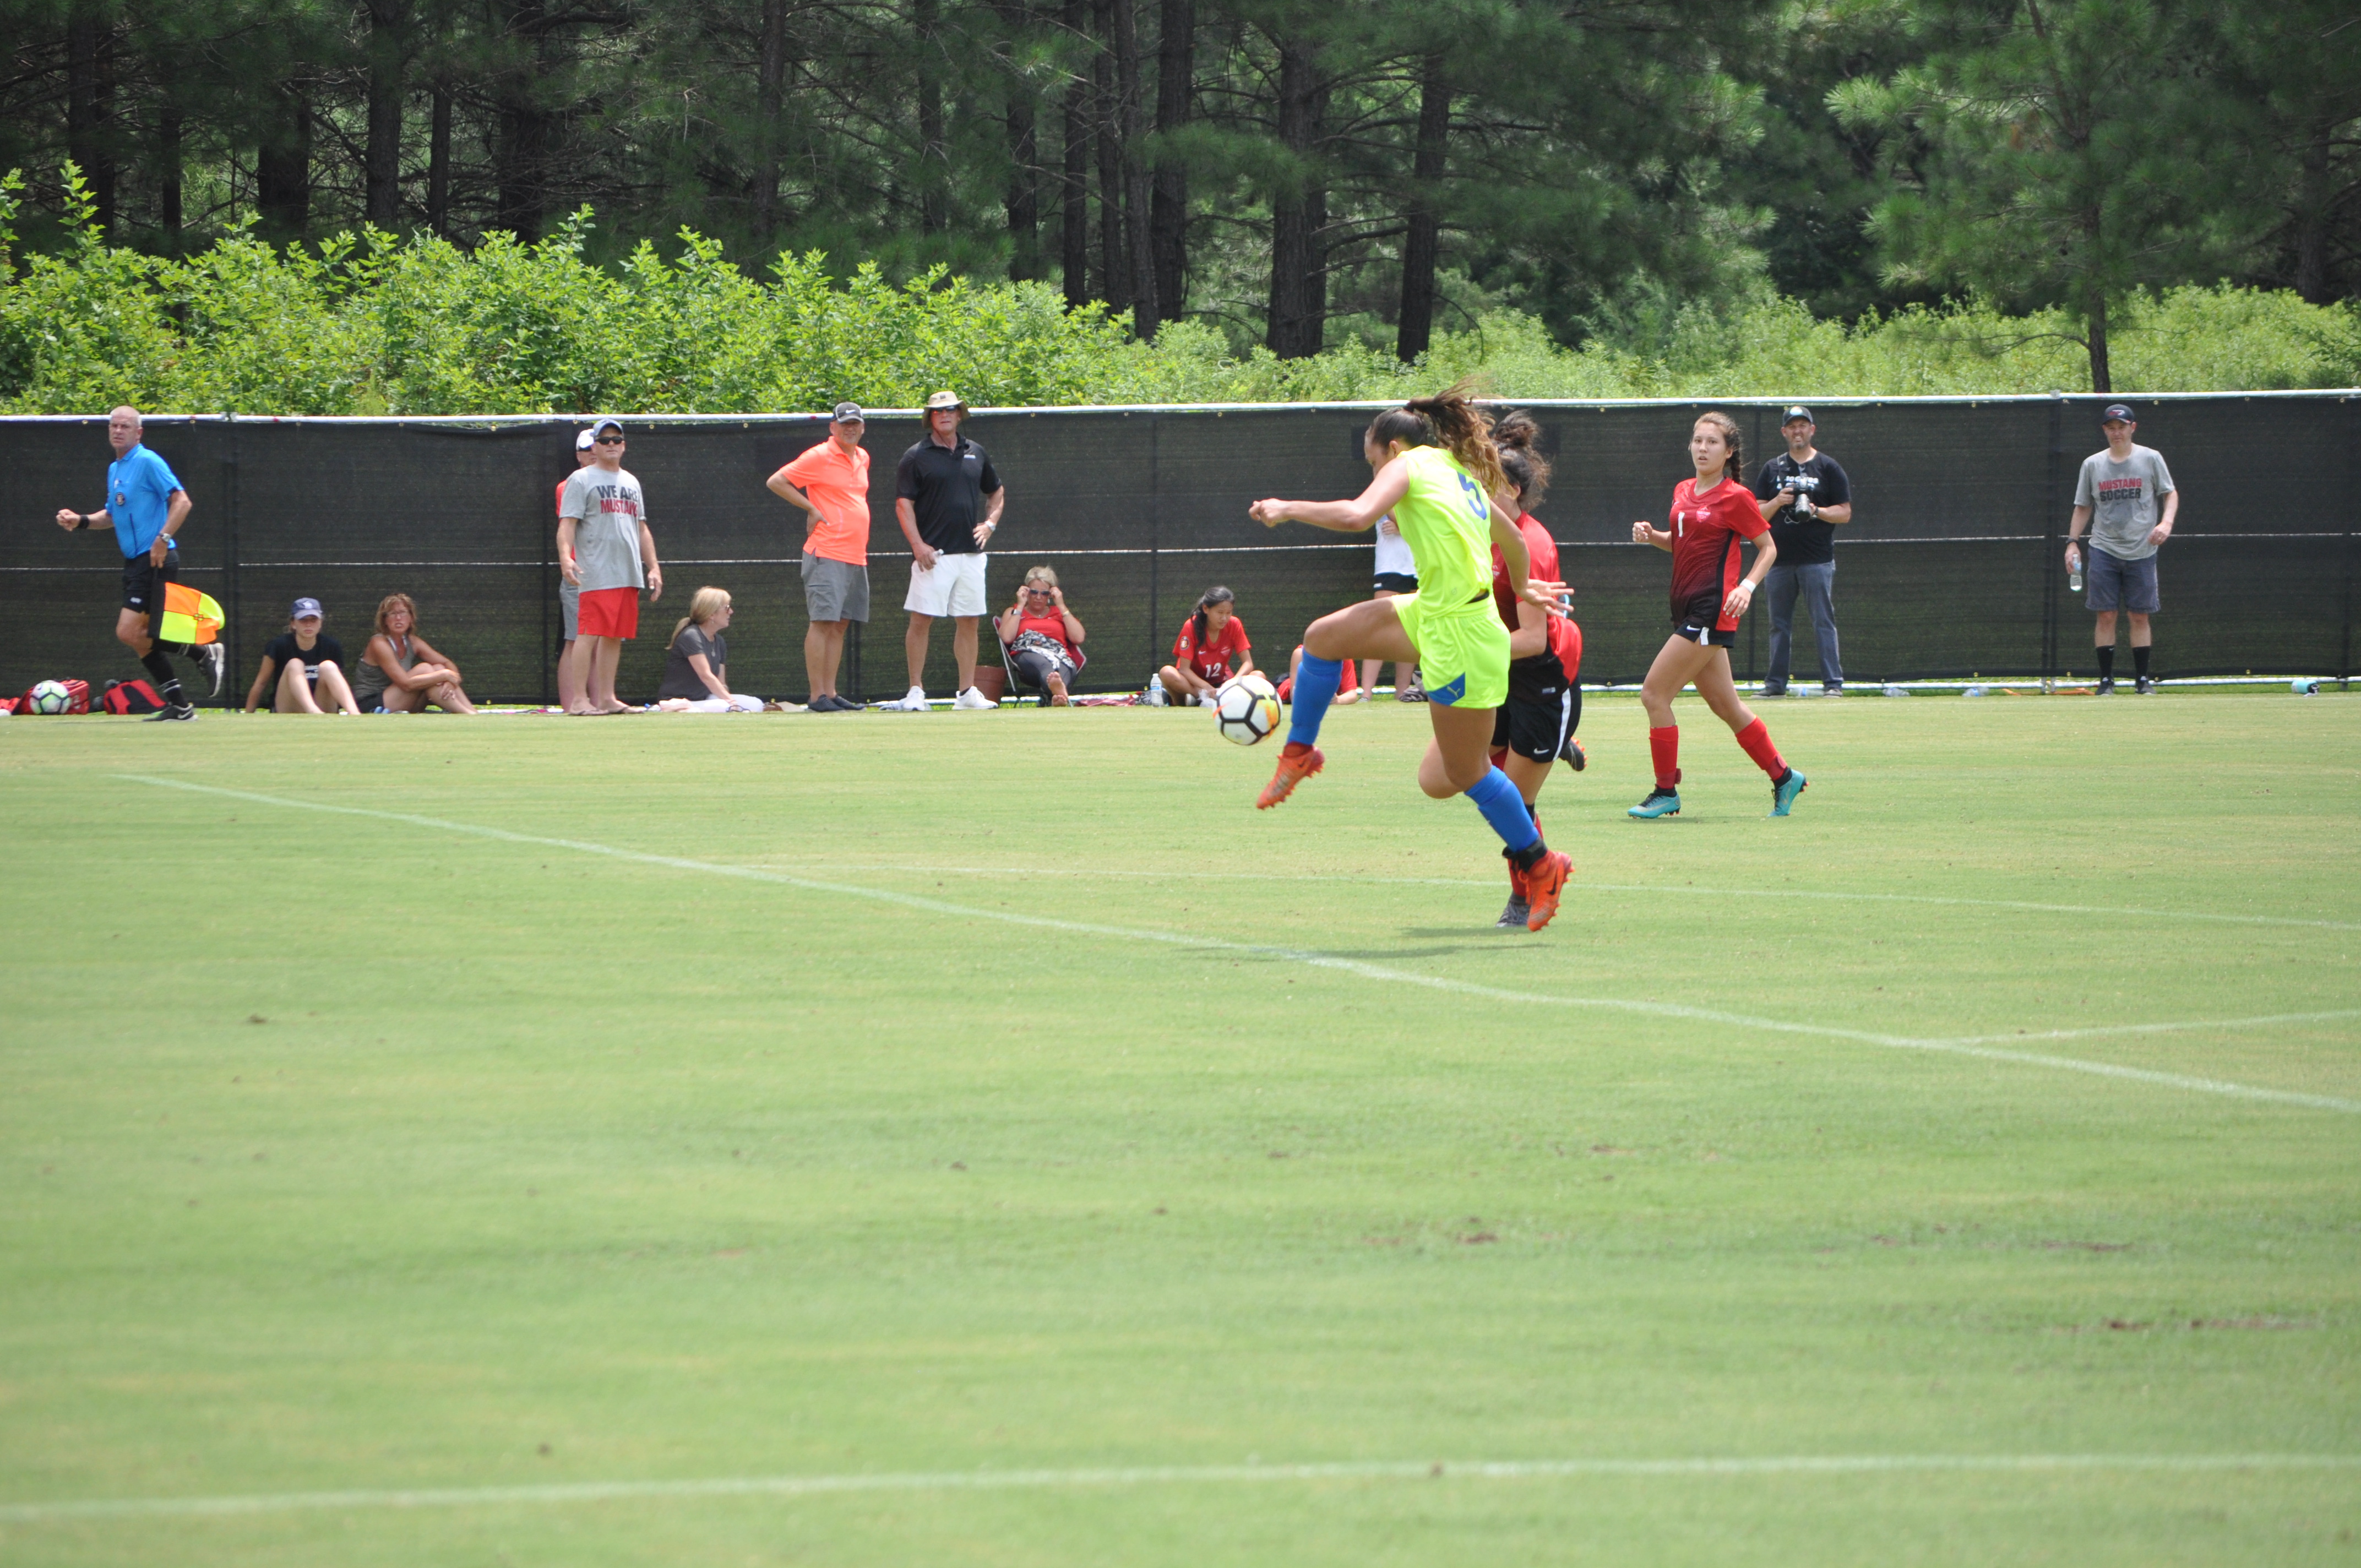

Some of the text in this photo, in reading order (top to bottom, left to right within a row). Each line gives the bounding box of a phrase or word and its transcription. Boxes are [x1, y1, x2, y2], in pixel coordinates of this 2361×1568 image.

[2098, 478, 2142, 491] MUSTANG
[596, 485, 638, 502] WE ARE
[1457, 471, 1487, 521] 5
[2099, 488, 2141, 502] SOCCER
[1678, 511, 1685, 537] 1
[1205, 662, 1222, 678] 12
